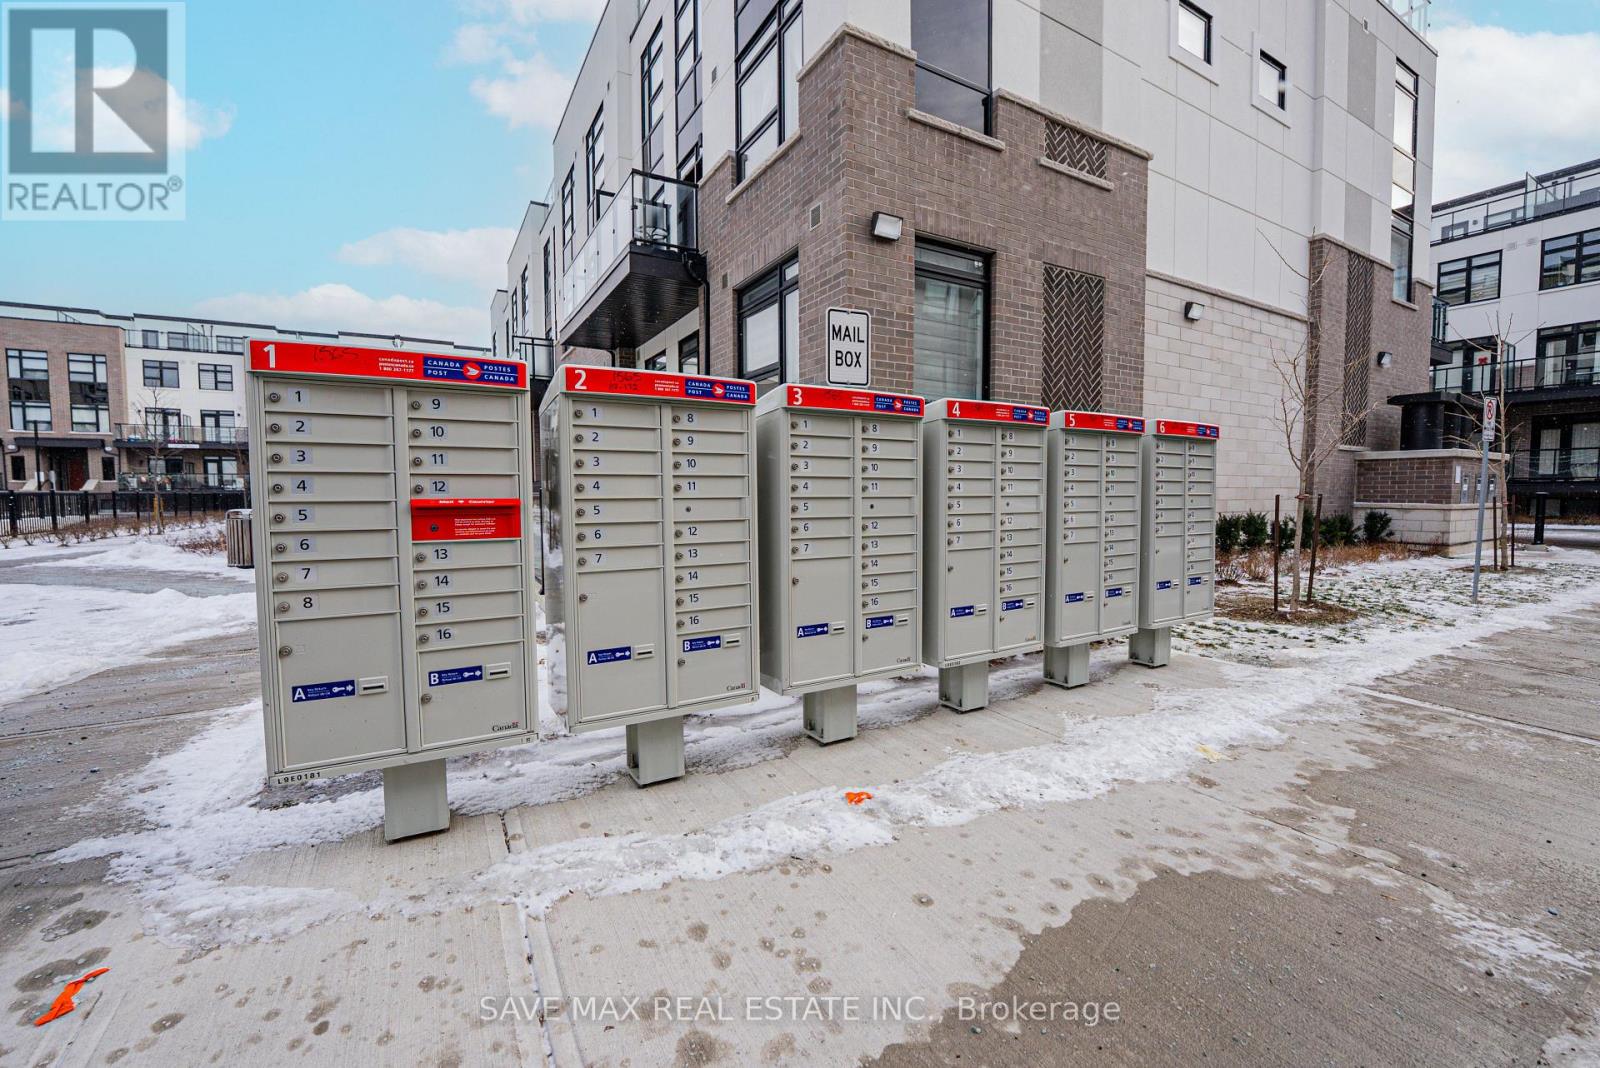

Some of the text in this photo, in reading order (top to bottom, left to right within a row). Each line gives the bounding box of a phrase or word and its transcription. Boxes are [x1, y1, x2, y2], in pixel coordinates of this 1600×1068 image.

[832, 324, 864, 343] MAIL
[263, 344, 276, 368] 1
[835, 350, 861, 368] BOX
[574, 370, 587, 390] 2
[295, 390, 301, 402] 1
[793, 388, 802, 405] 3
[431, 398, 441, 410] 9
[592, 407, 597, 417] 1
[952, 402, 960, 417] 4
[687, 413, 694, 423] 8
[1069, 414, 1075, 426] 5
[295, 420, 305, 433] 2
[803, 419, 808, 428] 1
[872, 423, 878, 433] 8
[1160, 422, 1165, 433] 6
[430, 426, 444, 438] 10
[592, 431, 599, 442] 2
[957, 429, 961, 437] 1
[687, 435, 694, 446] 9
[803, 440, 809, 449] 2
[872, 443, 878, 452] 9
[956, 447, 962, 455] 2
[296, 450, 306, 462] 3
[1008, 449, 1013, 457] 9
[431, 453, 444, 465] 11
[593, 456, 600, 467] 3
[686, 458, 697, 468] 10
[803, 460, 809, 470] 3
[871, 463, 879, 472] 10
[957, 464, 962, 473] 3
[1007, 465, 1014, 474] 10
[296, 479, 307, 492] 4
[432, 480, 446, 492] 12
[592, 480, 600, 490] 4
[687, 481, 696, 491] 11
[802, 481, 809, 490] 4
[871, 482, 878, 490] 11
[803, 502, 809, 511] 5
[956, 500, 961, 509] 5
[298, 509, 308, 521] 5
[593, 505, 601, 515] 5
[871, 520, 879, 530] 12
[1006, 516, 1013, 525] 12
[688, 526, 698, 536] 12
[803, 522, 809, 532] 6
[594, 529, 602, 540] 6
[956, 535, 961, 544] 7
[1006, 533, 1013, 541] 13
[299, 538, 310, 551] 6
[804, 543, 809, 552] 7
[870, 540, 879, 549] 13
[434, 548, 448, 560] 13
[595, 553, 602, 563] 7
[688, 548, 698, 558] 13
[870, 559, 878, 567] 14
[301, 567, 311, 580] 7
[1006, 566, 1013, 575] 15
[435, 575, 449, 587] 14
[688, 571, 698, 581] 14
[871, 578, 879, 587] 15
[1006, 583, 1013, 591] 16
[303, 596, 313, 609] 8
[688, 593, 699, 603] 15
[871, 597, 879, 606] 16
[436, 601, 450, 613] 15
[689, 615, 700, 625] 16
[866, 619, 871, 627] B
[436, 628, 452, 640] 16
[798, 628, 804, 637] A
[684, 641, 690, 651] B
[588, 652, 598, 664] A
[430, 673, 439, 684] B
[294, 688, 306, 701] A
[278, 772, 321, 784] L9E0181
